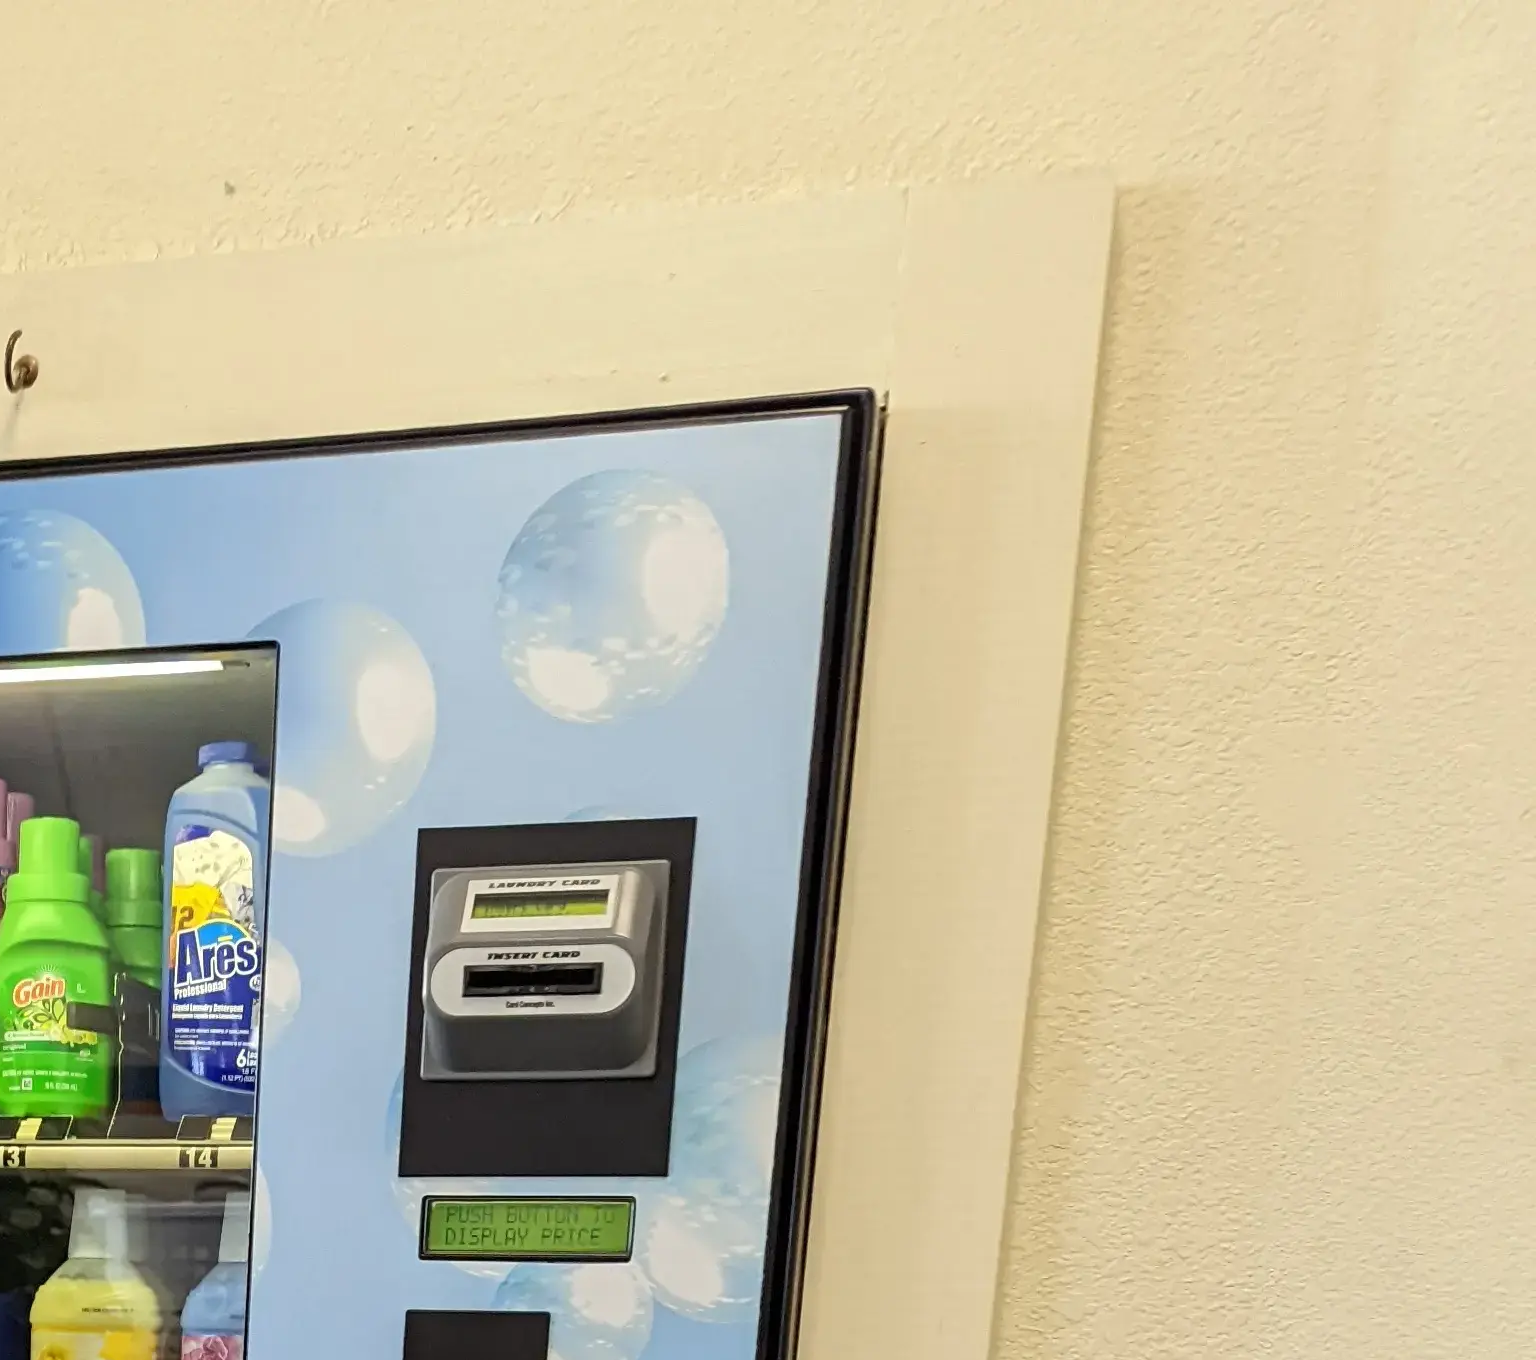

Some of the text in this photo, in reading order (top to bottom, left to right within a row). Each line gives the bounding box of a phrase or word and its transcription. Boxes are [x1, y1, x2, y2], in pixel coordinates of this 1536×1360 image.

[488, 879, 601, 889] LAUNDRY CARD
[486, 950, 581, 960] INSERT CARD
[13, 978, 65, 1007] Gain
[236, 1049, 247, 1067] 6
[186, 1146, 213, 1168] 14
[445, 1205, 494, 1224] PUSH
[506, 1205, 579, 1224] BUTTON
[444, 1228, 601, 1246] DISPLAY PRICE
